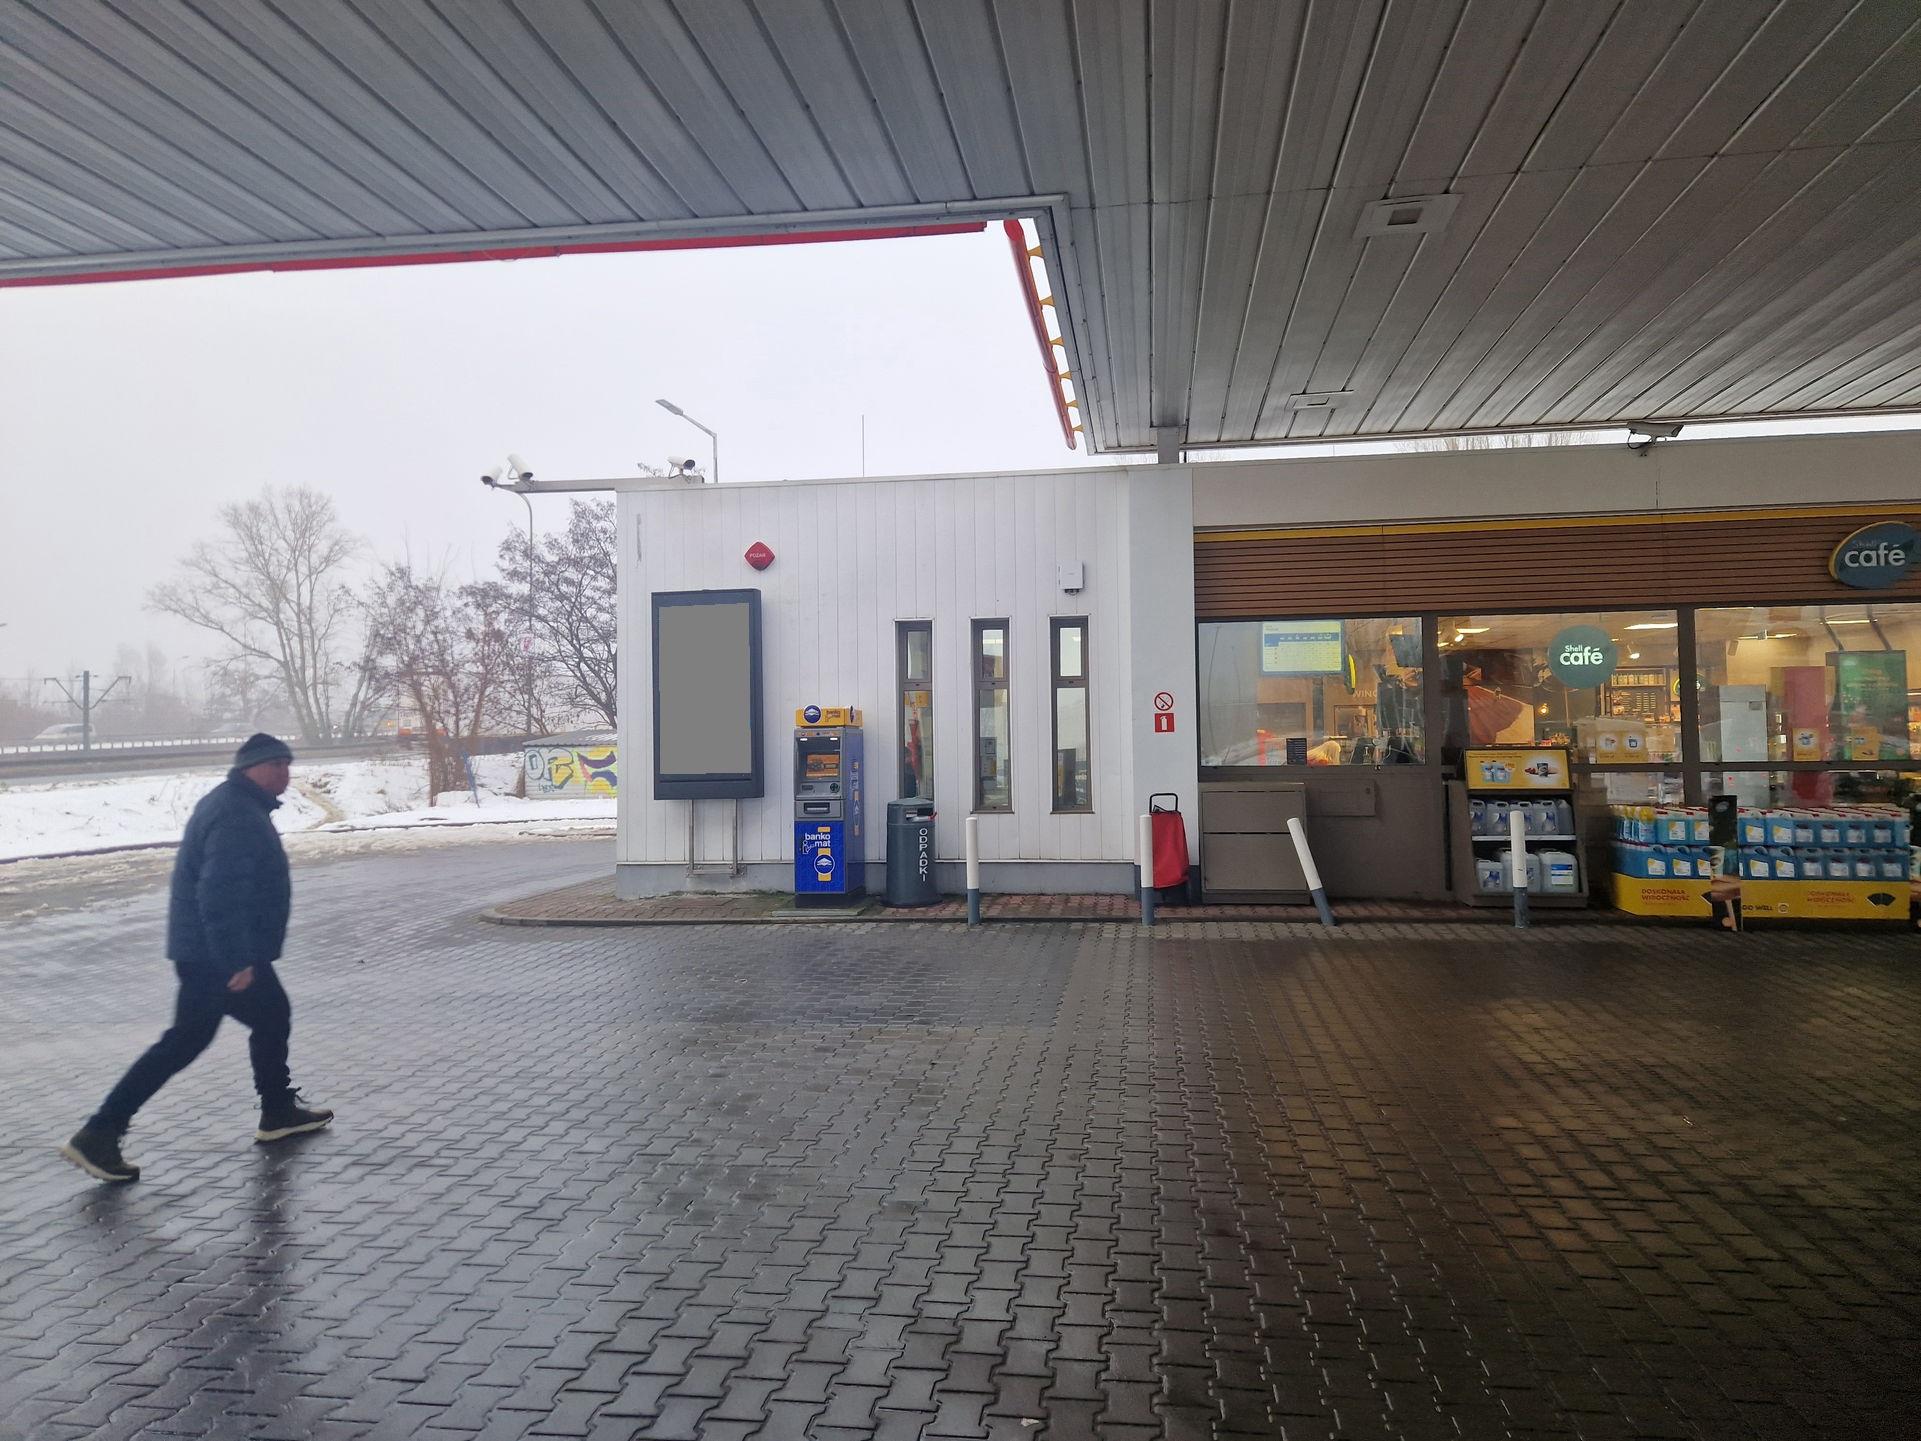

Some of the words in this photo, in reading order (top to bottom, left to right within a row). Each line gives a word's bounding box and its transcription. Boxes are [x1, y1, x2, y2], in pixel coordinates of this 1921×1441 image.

[1844, 542, 1906, 567] café
[1559, 646, 1603, 665] café
[1565, 644, 1583, 652] Shell
[805, 832, 831, 840] banko
[919, 828, 928, 882] ODPADKI
